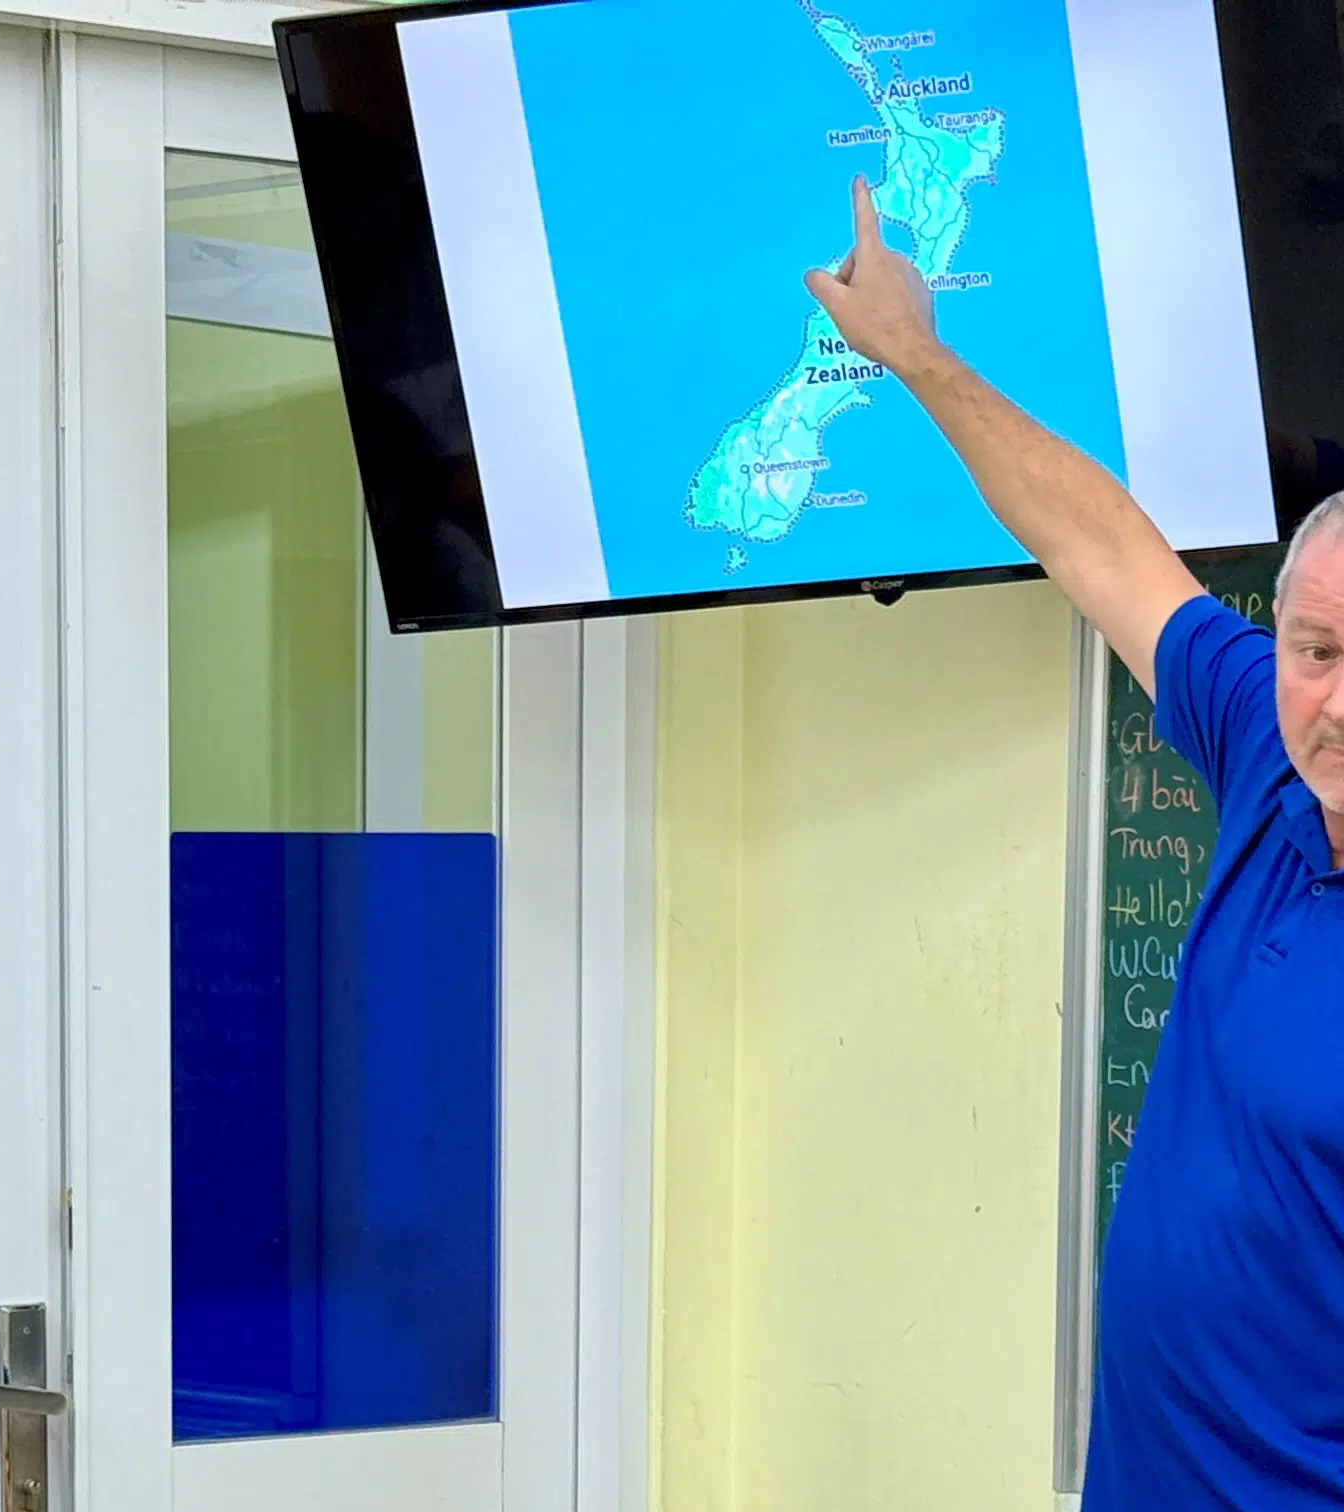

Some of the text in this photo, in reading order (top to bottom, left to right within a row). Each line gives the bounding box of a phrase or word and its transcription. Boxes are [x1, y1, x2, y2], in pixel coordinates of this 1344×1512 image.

[888, 73, 970, 99] Auckland
[938, 111, 997, 127] Tauranga
[829, 129, 892, 145] Hamilton
[927, 272, 990, 289] ellington
[819, 337, 852, 355] Ne
[805, 363, 884, 385] Zealand
[753, 457, 829, 474] Queenstown
[816, 492, 866, 507] Dunedin
